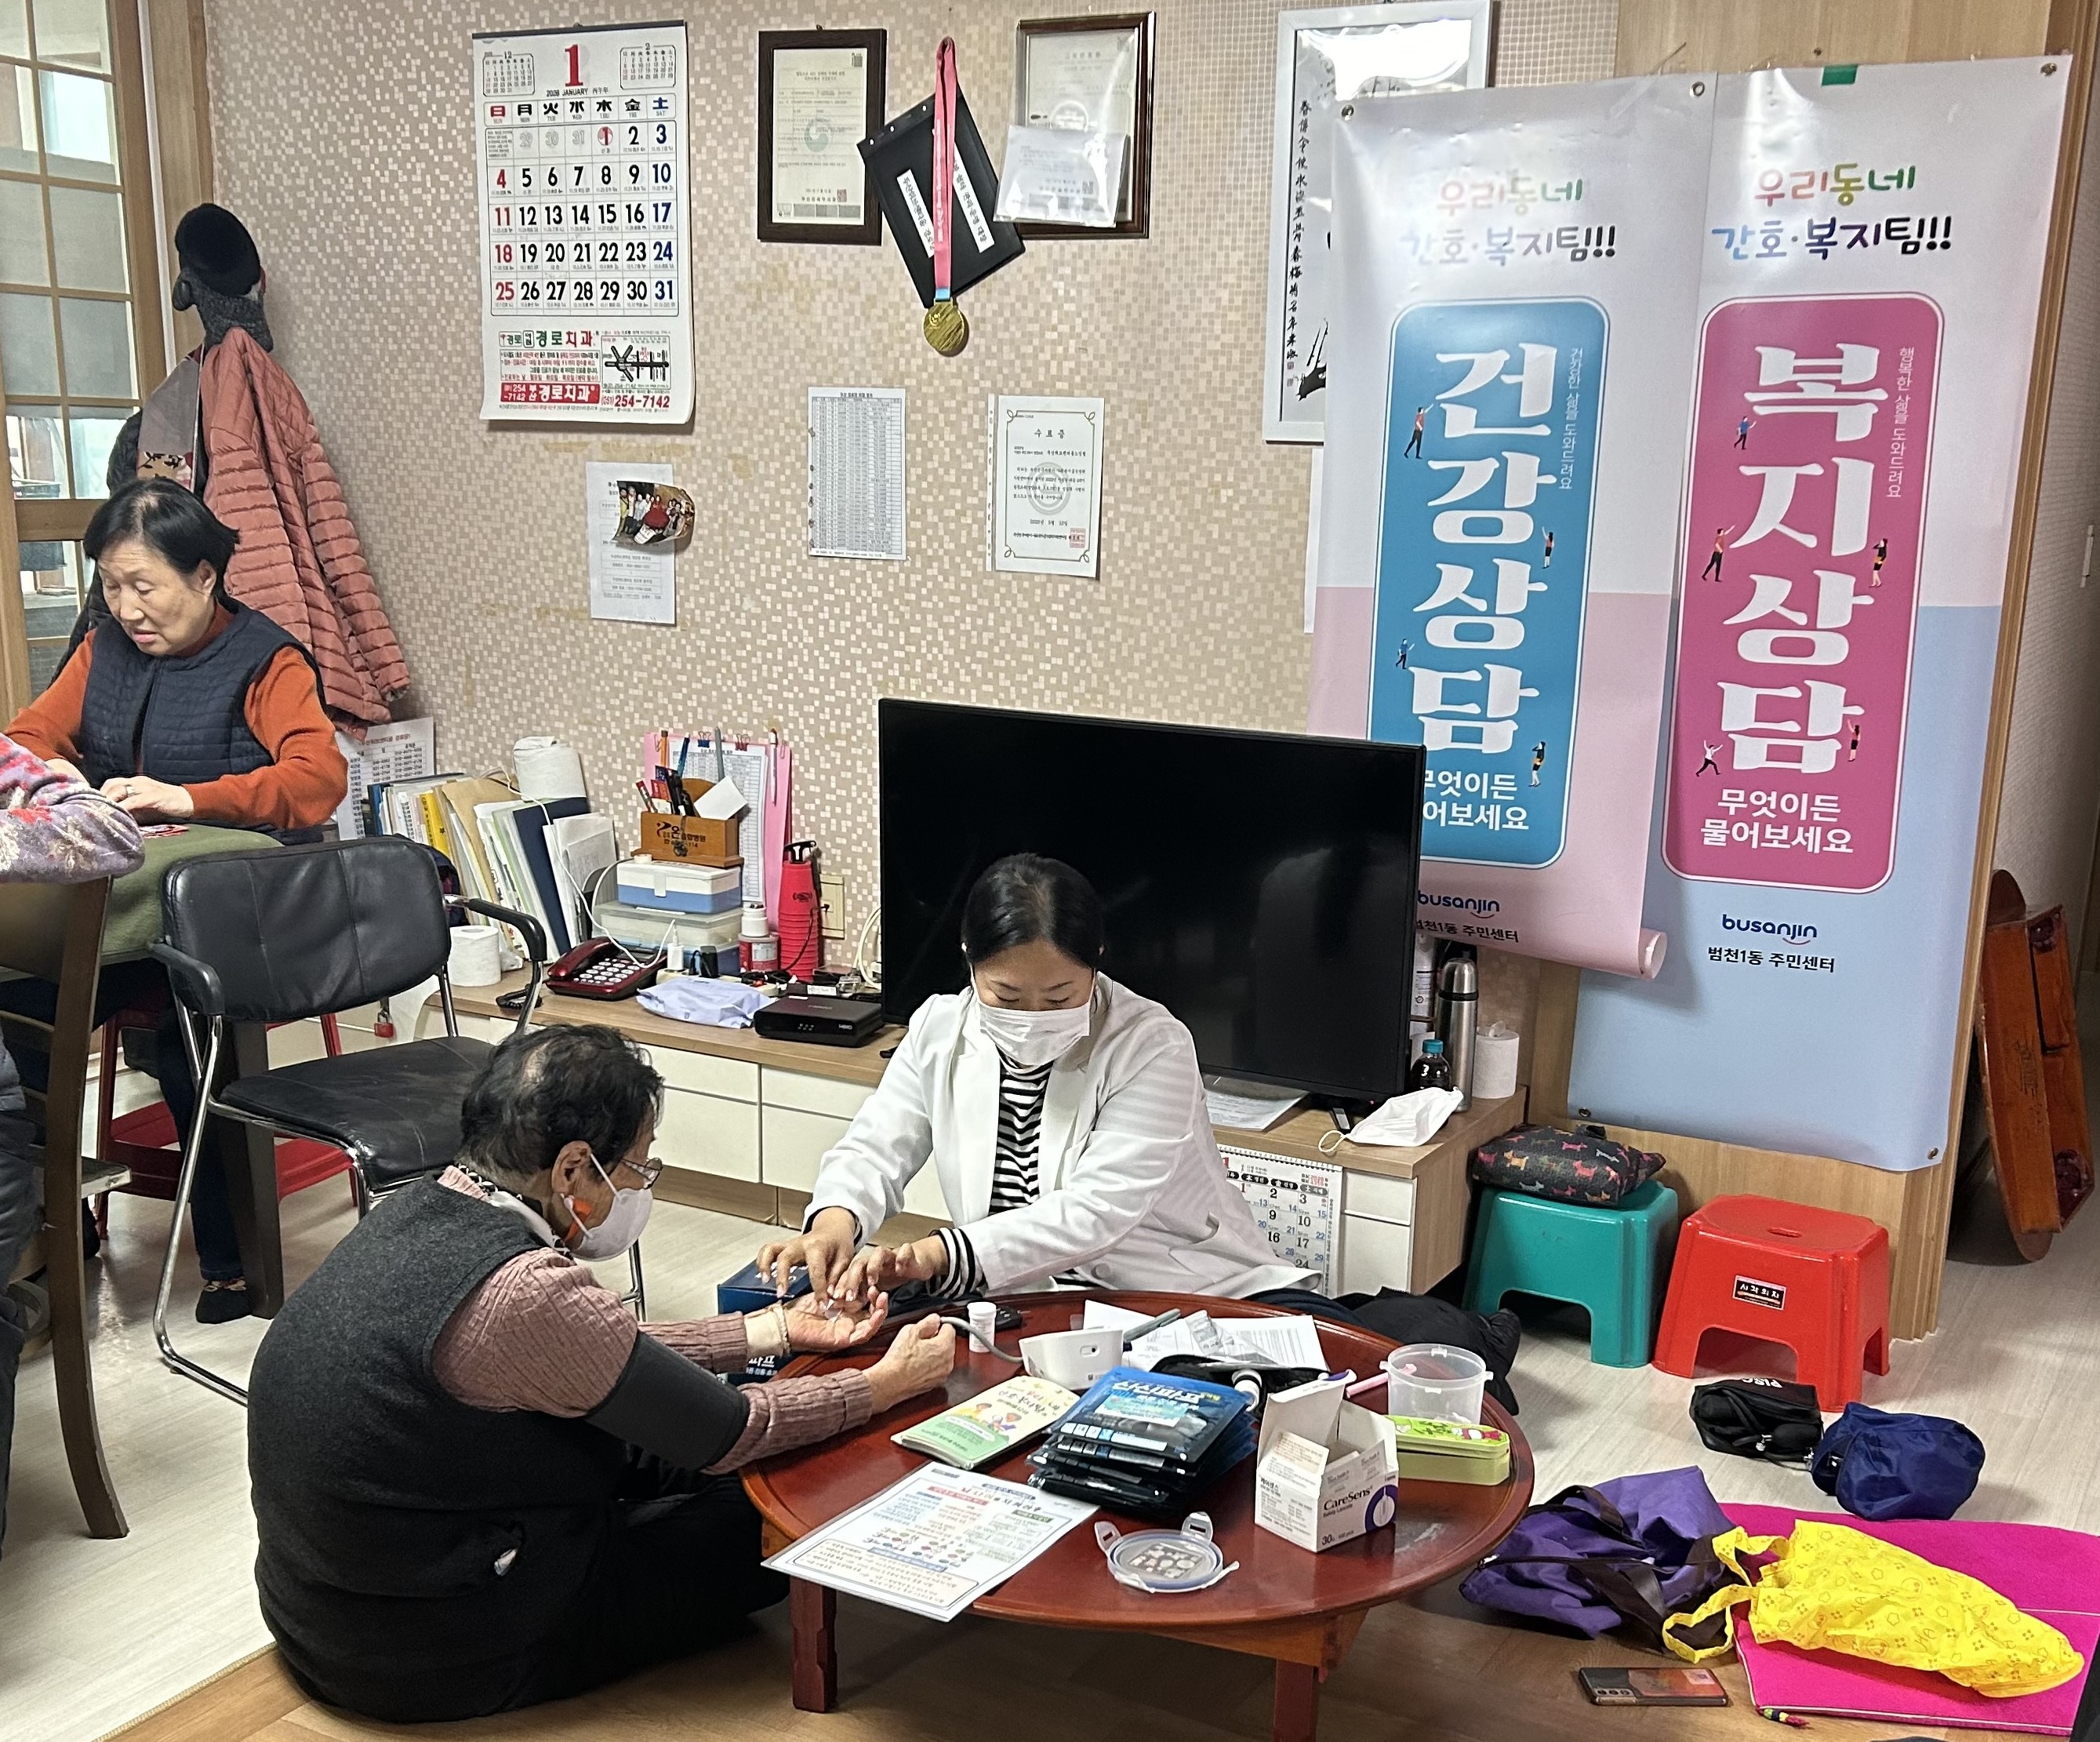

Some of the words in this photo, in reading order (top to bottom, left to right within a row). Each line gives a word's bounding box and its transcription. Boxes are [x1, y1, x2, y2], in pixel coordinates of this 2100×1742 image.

[565, 44, 583, 86] 1
[491, 106, 505, 117] 日
[518, 104, 532, 115] 月
[543, 103, 558, 115] 火
[596, 100, 612, 111] 木
[625, 99, 640, 111] 金
[652, 97, 668, 109] 土
[603, 126, 609, 145] 1
[629, 126, 639, 145] 2
[656, 124, 667, 144] 3
[497, 169, 506, 188] 4
[522, 168, 532, 187] 5
[548, 167, 558, 186] 6
[574, 166, 583, 186] 7
[601, 165, 612, 184] 8
[629, 165, 639, 184] 9
[652, 163, 671, 183] 10
[1755, 162, 1916, 206] 우리동네
[1437, 170, 1582, 216] 우리동네
[495, 207, 510, 226] 11
[519, 206, 536, 226] 12
[545, 205, 563, 224] 13
[572, 205, 589, 224] 14
[598, 204, 616, 224] 15
[626, 203, 644, 223] 16
[652, 202, 671, 223] 17
[495, 244, 512, 263] 18
[521, 244, 537, 263] 19
[545, 243, 565, 262] 20
[574, 242, 590, 262] 21
[599, 242, 619, 262] 22
[626, 242, 646, 261] 23
[653, 241, 673, 261] 24
[496, 282, 514, 300] 25
[521, 282, 540, 300] 26
[547, 282, 566, 300] 27
[574, 281, 593, 300] 28
[600, 281, 619, 300] 29
[627, 281, 647, 300] 30
[655, 280, 673, 300] 31
[536, 330, 593, 347] 경로치과
[1898, 347, 1914, 391] 행복한
[539, 384, 590, 402] 경로치과
[615, 395, 670, 408] 254-7142
[1894, 395, 1911, 424] 삶을
[1886, 428, 1907, 498] 도와드려요
[1408, 342, 1558, 755] 건강상담
[1717, 342, 1887, 774] 복지상담
[1422, 801, 1529, 831] 어보세요
[1718, 788, 1841, 823] 무엇이든
[1700, 818, 1854, 854] 물어보세요
[1418, 890, 1500, 914] busanjin
[1462, 925, 1519, 943] 주민센터
[1722, 914, 1818, 940] busanjin
[1708, 947, 1764, 966] 범천1동
[1769, 952, 1835, 973] 주민센터
[1241, 1183, 1246, 1193] 1
[1270, 1188, 1277, 1198] 2
[1299, 1194, 1307, 1204] 3
[1259, 1198, 1268, 1207] 13
[1269, 1209, 1277, 1220] 9
[1298, 1215, 1311, 1227] 10
[1268, 1231, 1281, 1243] 16
[1297, 1237, 1310, 1249] 17
[1287, 1226, 1295, 1235] 21
[1316, 1231, 1325, 1240] 22
[1295, 1259, 1310, 1269] 24
[1315, 1253, 1324, 1262] 29
[1324, 1489, 1371, 1511] CareSens
